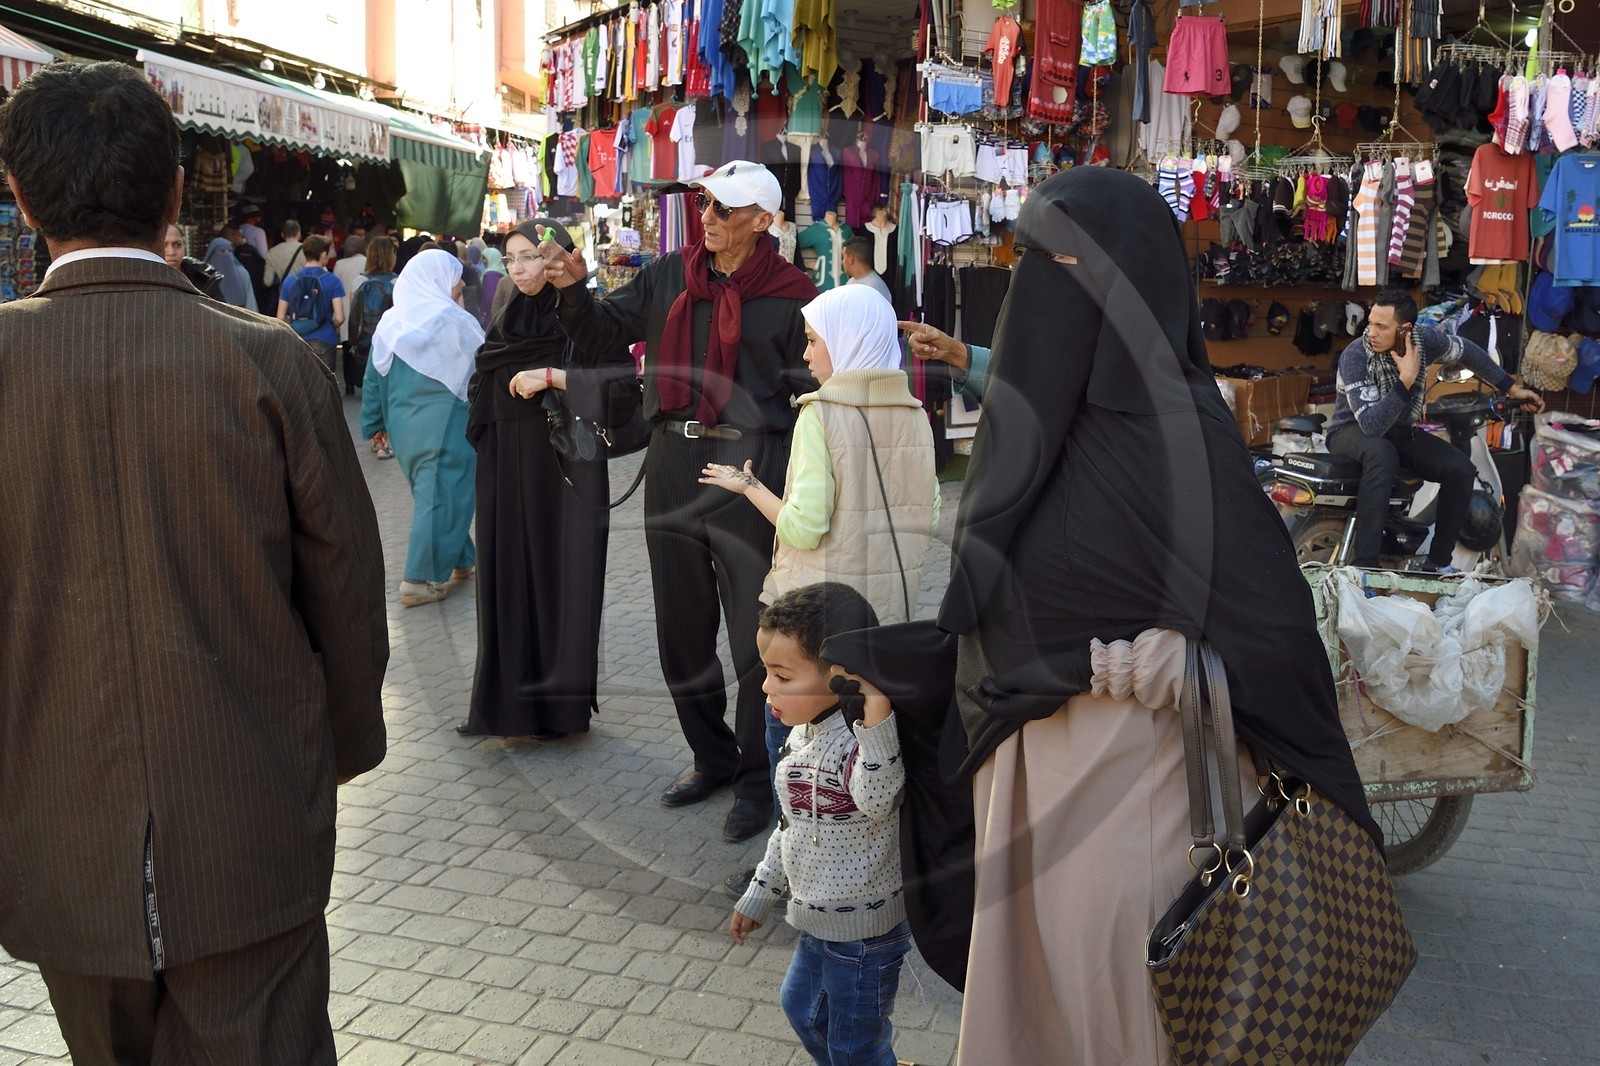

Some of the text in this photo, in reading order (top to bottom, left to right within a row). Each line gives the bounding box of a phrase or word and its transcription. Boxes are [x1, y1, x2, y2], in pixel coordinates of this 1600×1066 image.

[1215, 69, 1223, 82] 3
[1484, 176, 1518, 192] المغرب
[1287, 458, 1315, 470] DOCKER
